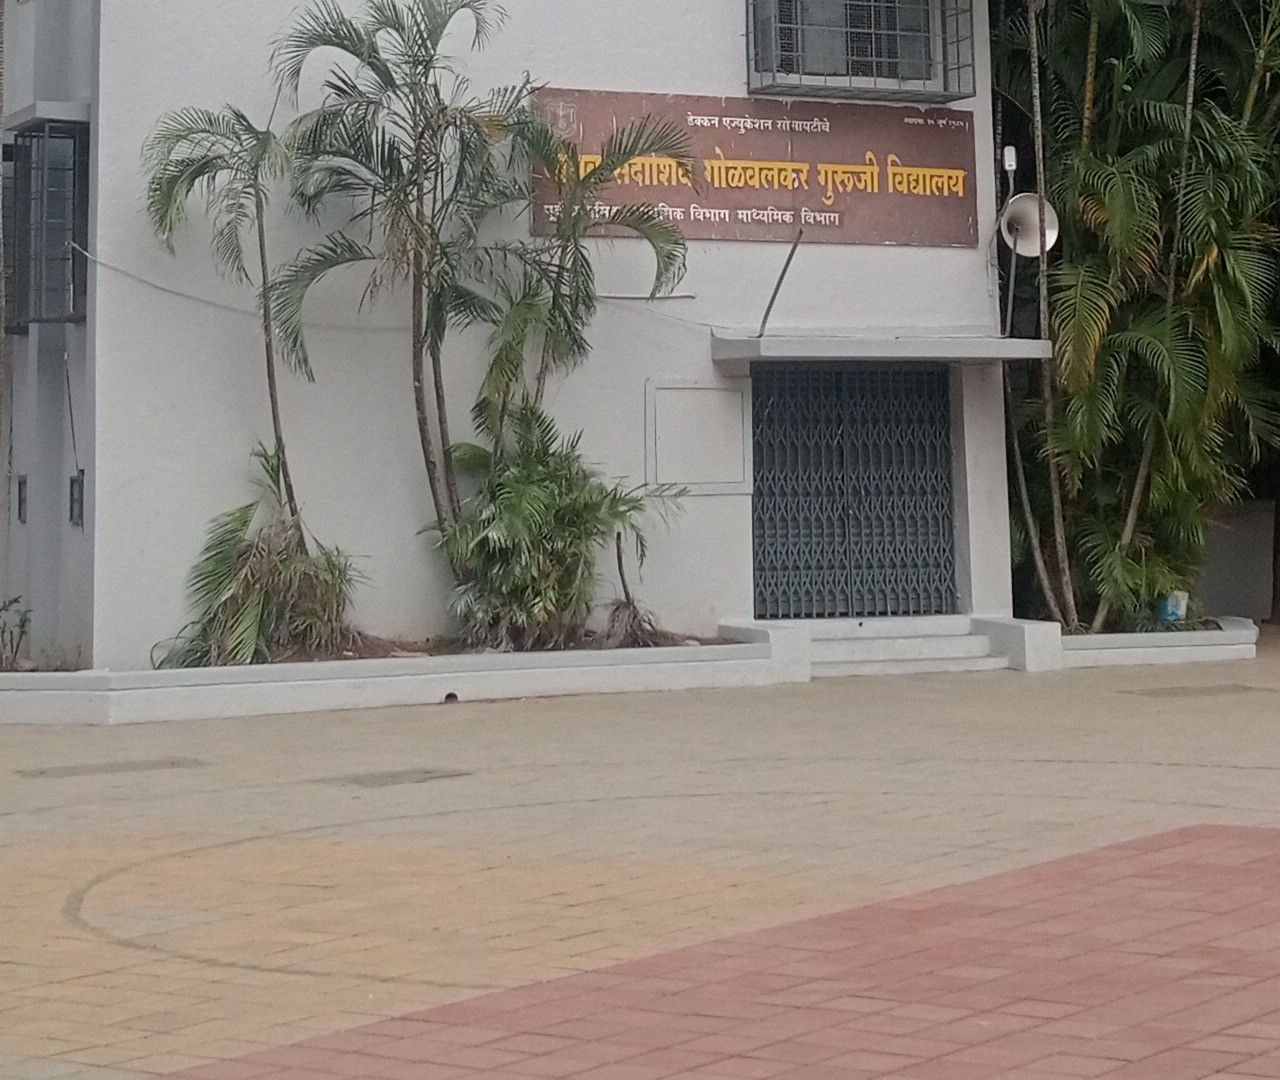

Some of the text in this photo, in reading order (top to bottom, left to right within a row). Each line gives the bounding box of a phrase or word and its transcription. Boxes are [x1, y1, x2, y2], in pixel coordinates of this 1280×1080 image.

[687, 112, 830, 134] डेक्कन एज्युकेशन सोसायटीचे
[704, 146, 809, 190] गोळवलकर
[887, 153, 965, 197] विद्यालय
[690, 203, 730, 222] विभाग
[736, 205, 794, 224] माध्यमिक
[800, 207, 840, 226] विभाग
